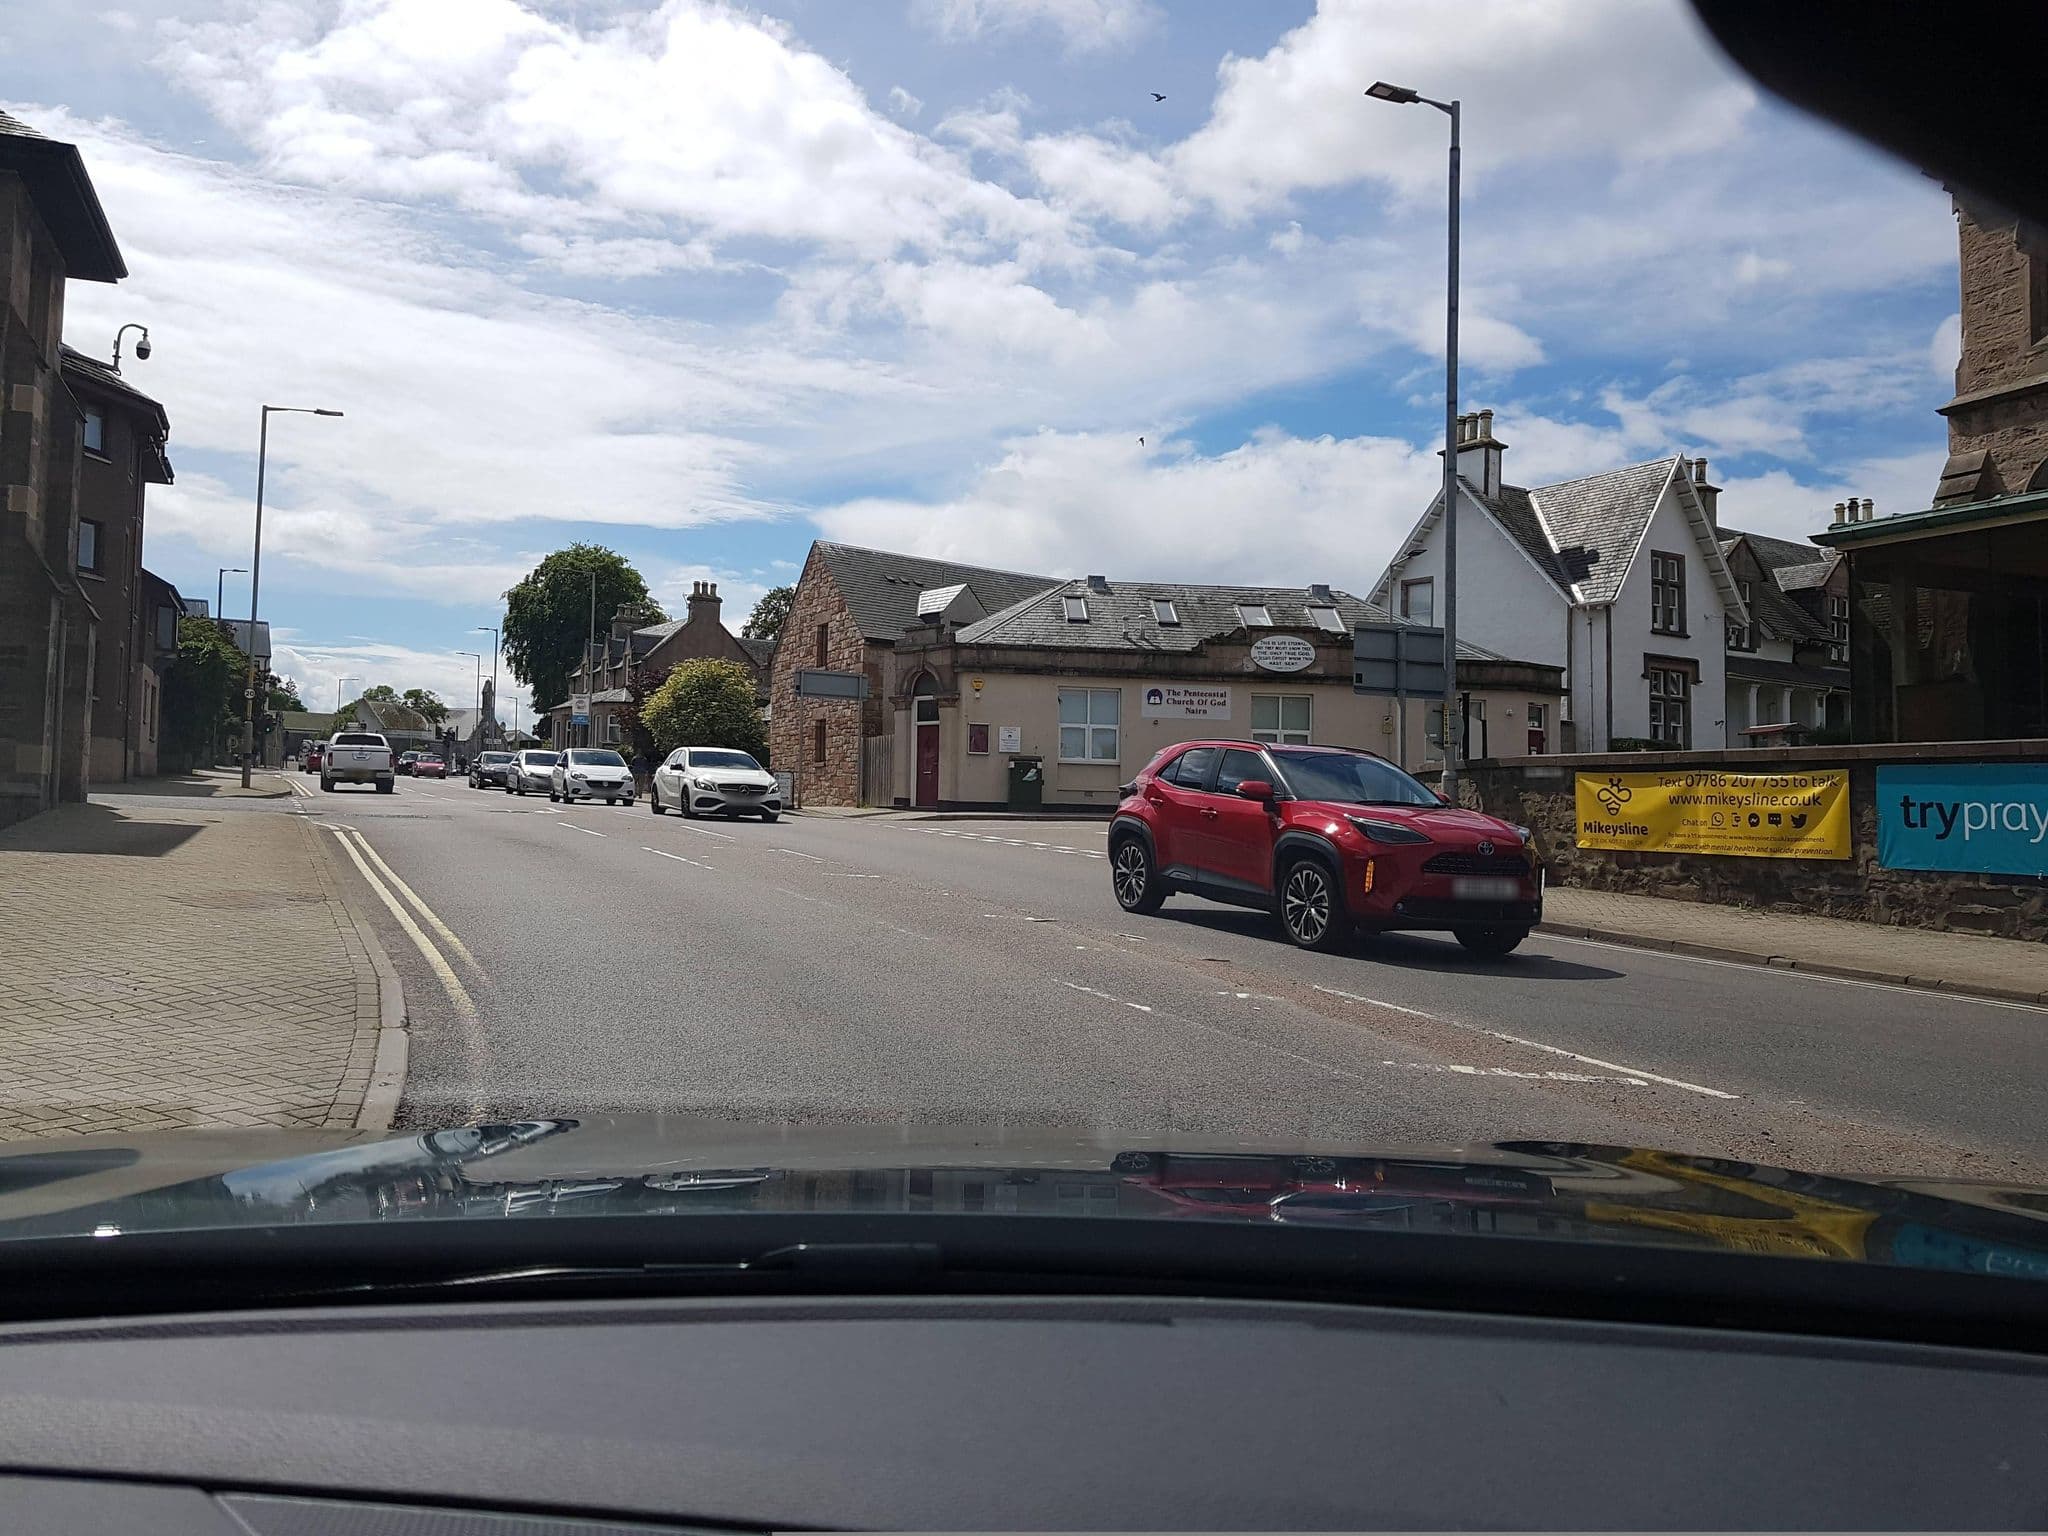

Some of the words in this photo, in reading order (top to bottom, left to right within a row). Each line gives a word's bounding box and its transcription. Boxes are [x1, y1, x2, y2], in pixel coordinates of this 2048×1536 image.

[1184, 690, 1227, 698] Pentecostal
[1658, 777, 1682, 788] Text
[1686, 774, 1727, 788] 07786
[1731, 776, 1755, 788] 207
[1763, 776, 1789, 788] 755
[1793, 777, 1807, 788] to
[1812, 776, 1840, 788] talk
[1669, 792, 1822, 808] www.mikeysline.co.uk
[1584, 821, 1648, 837] Mikeysline
